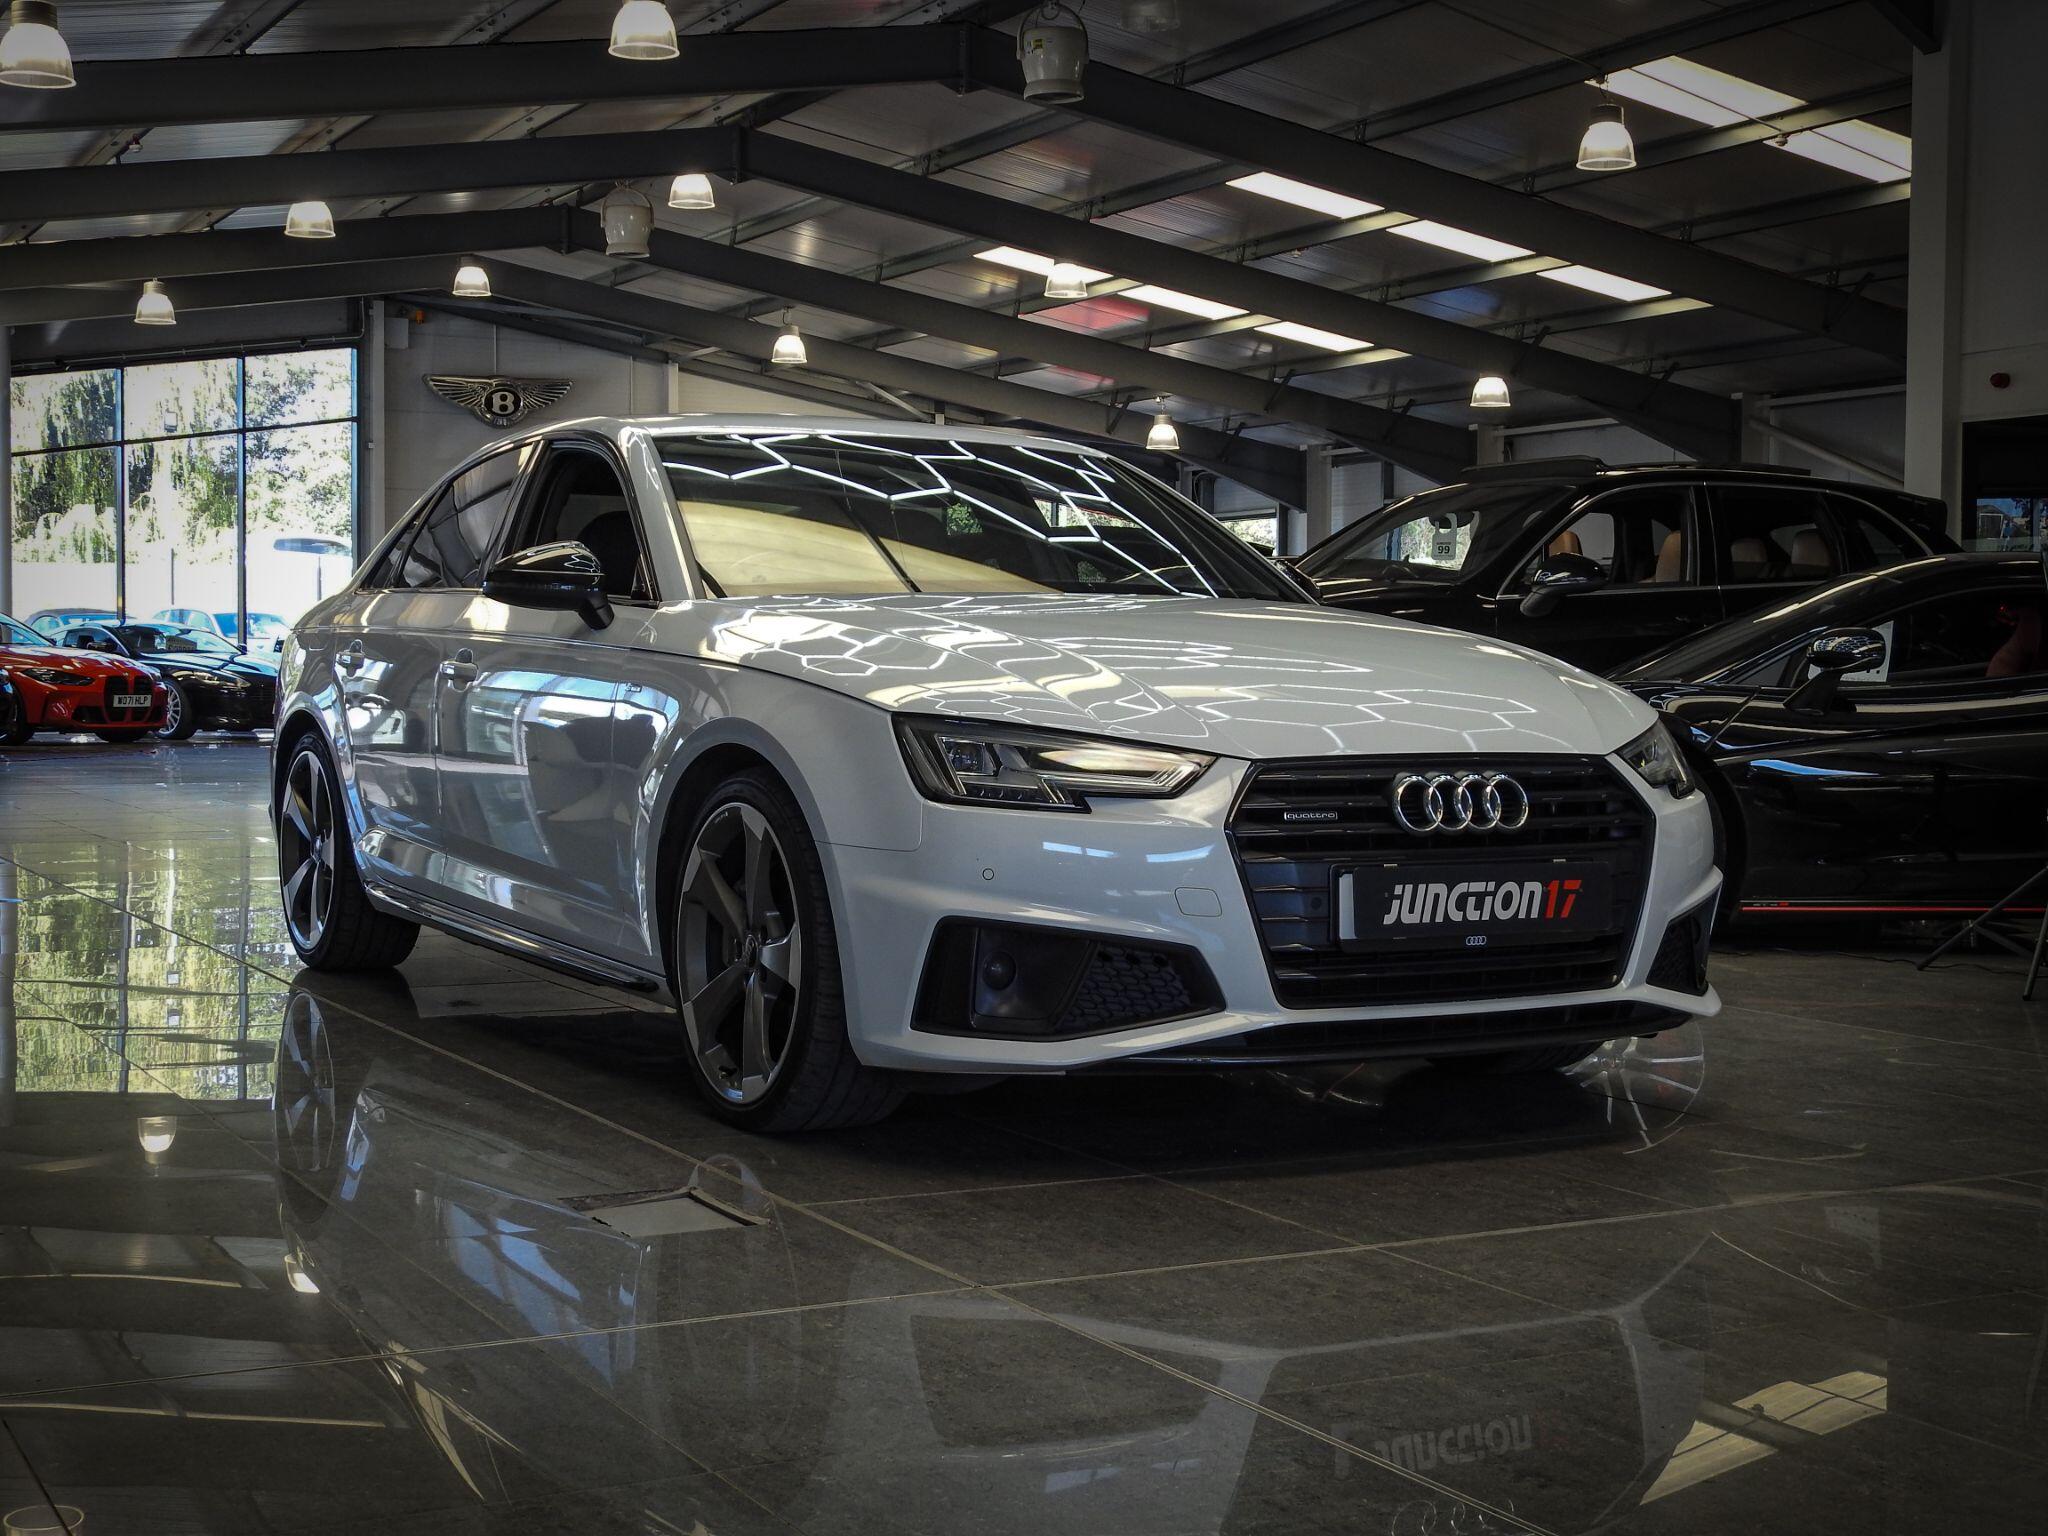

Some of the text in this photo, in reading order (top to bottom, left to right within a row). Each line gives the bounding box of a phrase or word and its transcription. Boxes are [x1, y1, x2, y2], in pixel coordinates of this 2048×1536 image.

[492, 391, 515, 415] B
[1438, 545, 1450, 554] 99
[1287, 812, 1336, 820] quattro
